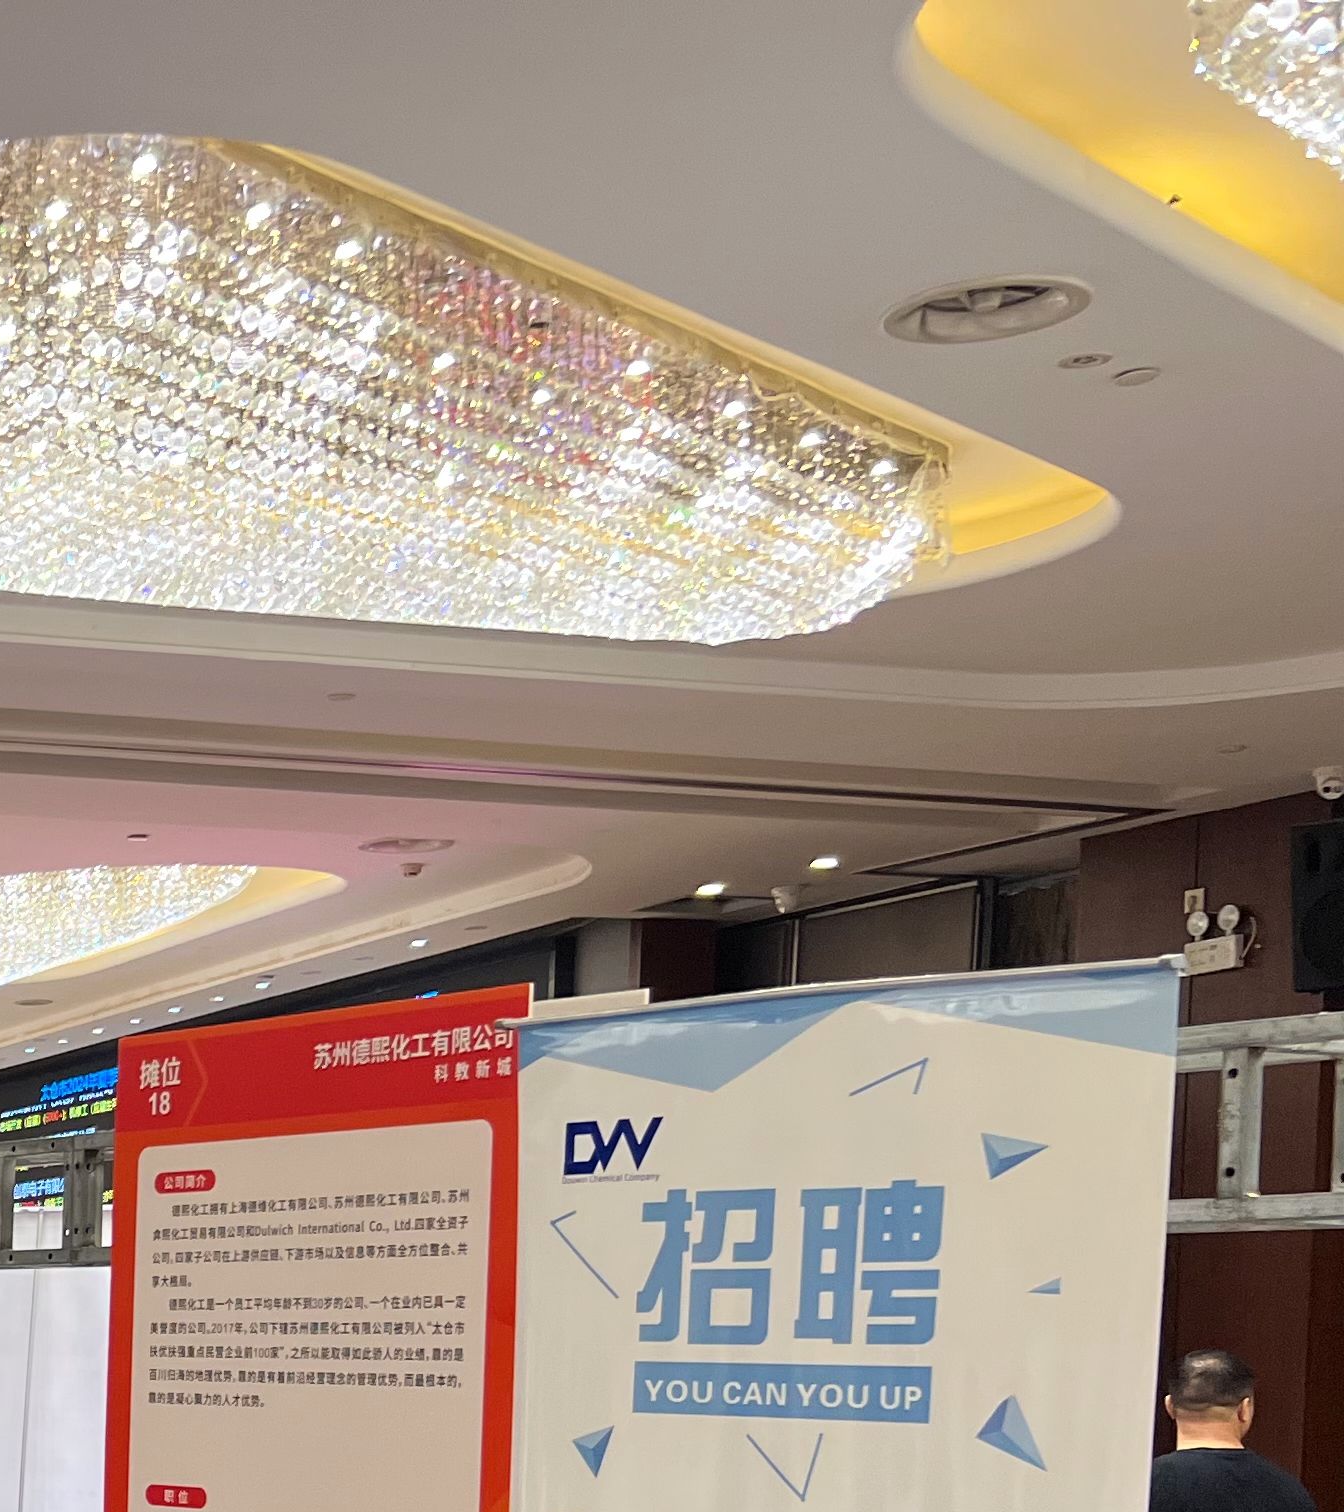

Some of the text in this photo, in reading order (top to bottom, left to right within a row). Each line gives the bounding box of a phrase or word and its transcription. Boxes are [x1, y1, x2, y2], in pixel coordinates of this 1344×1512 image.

[313, 1024, 513, 1071] 苏州德熙化工有限公司
[139, 1056, 181, 1090] 摊位
[148, 1092, 171, 1116] 18
[164, 1174, 207, 1190] 公司简介
[297, 1220, 365, 1235] International
[635, 1179, 945, 1345] 招聘
[644, 1378, 922, 1410] YOU CAN YOU UP
